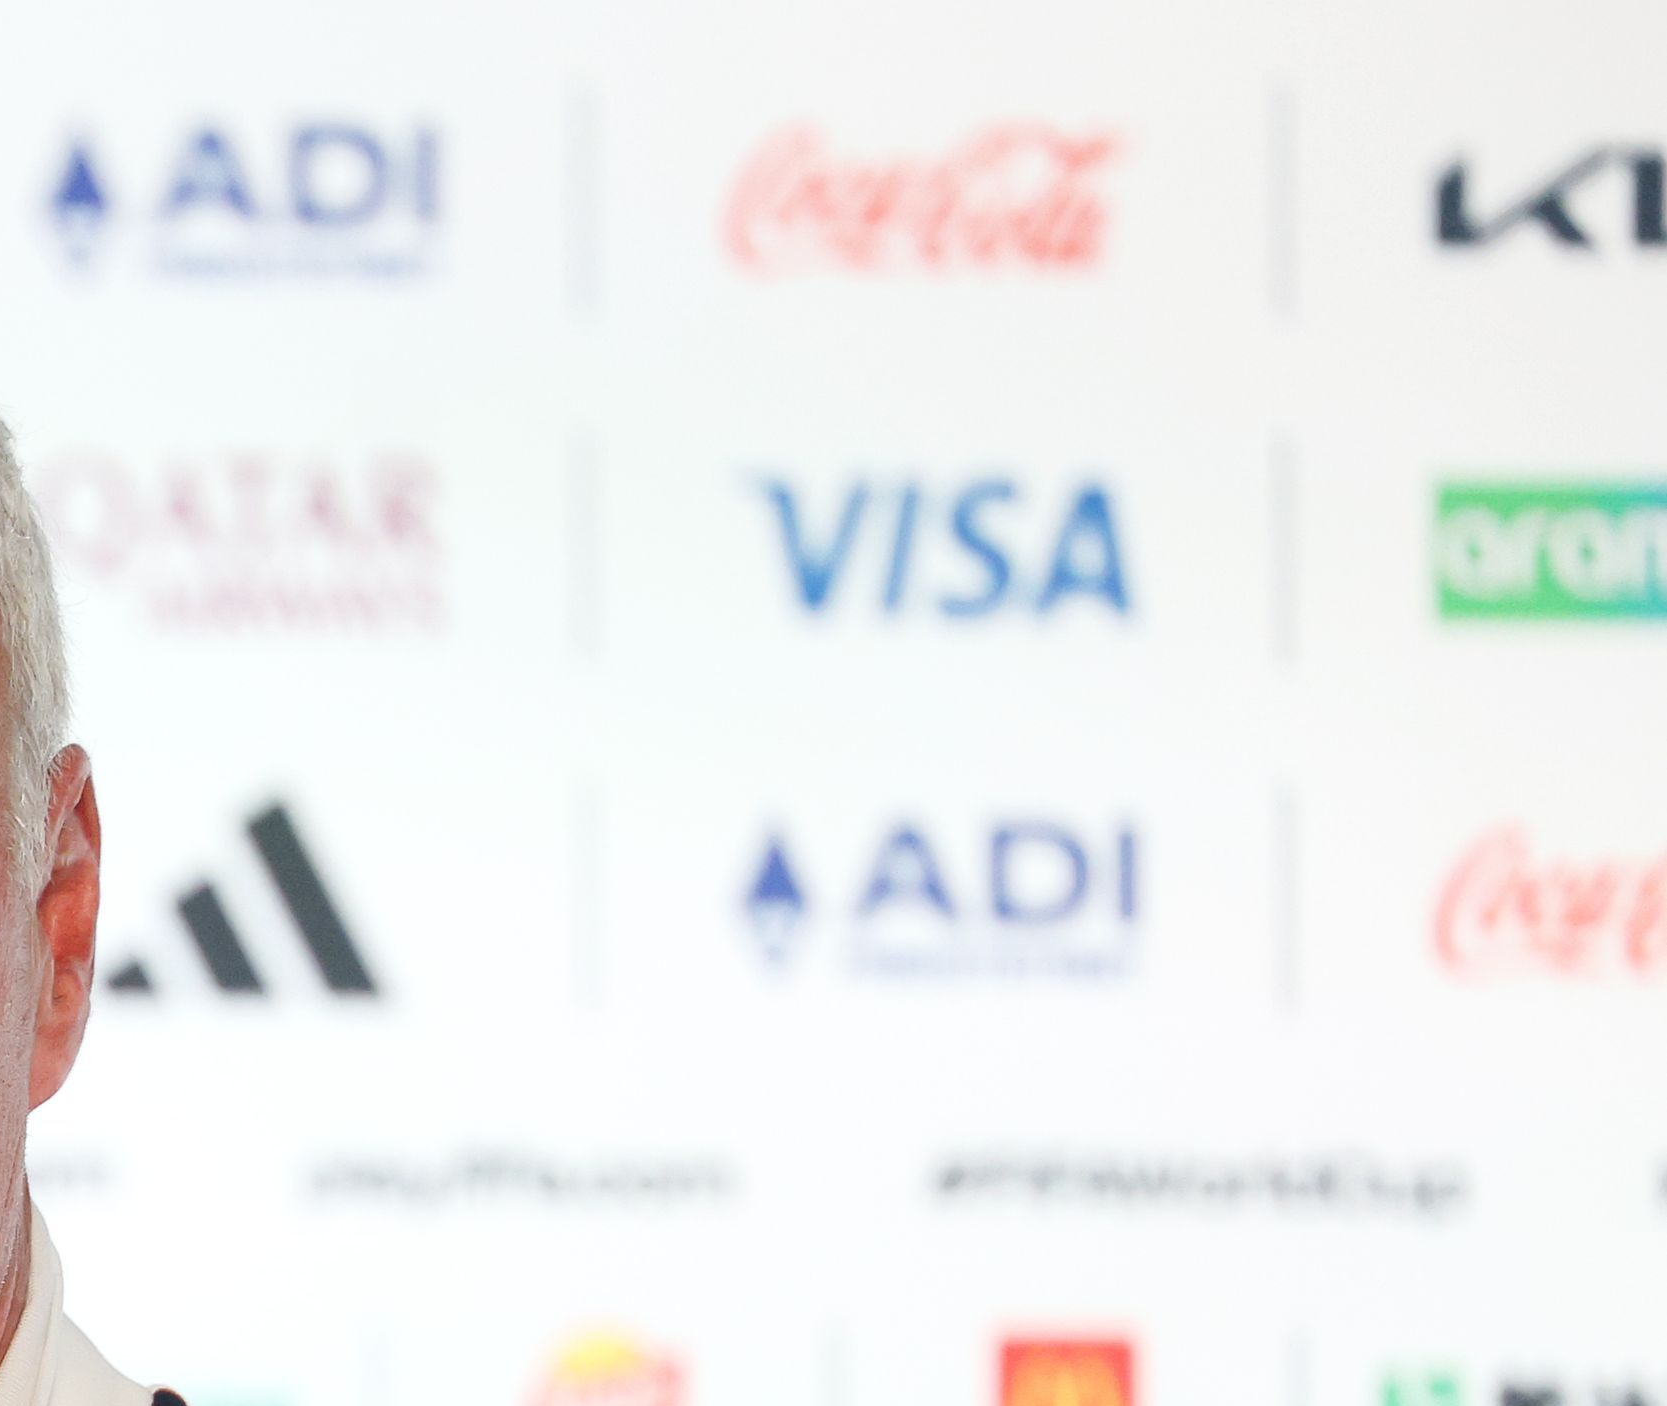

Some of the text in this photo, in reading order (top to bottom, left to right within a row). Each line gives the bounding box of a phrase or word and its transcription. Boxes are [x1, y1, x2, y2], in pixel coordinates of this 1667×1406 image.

[154, 118, 442, 230] ADI
[760, 475, 1134, 621] VISA
[853, 816, 1143, 930] ADI
